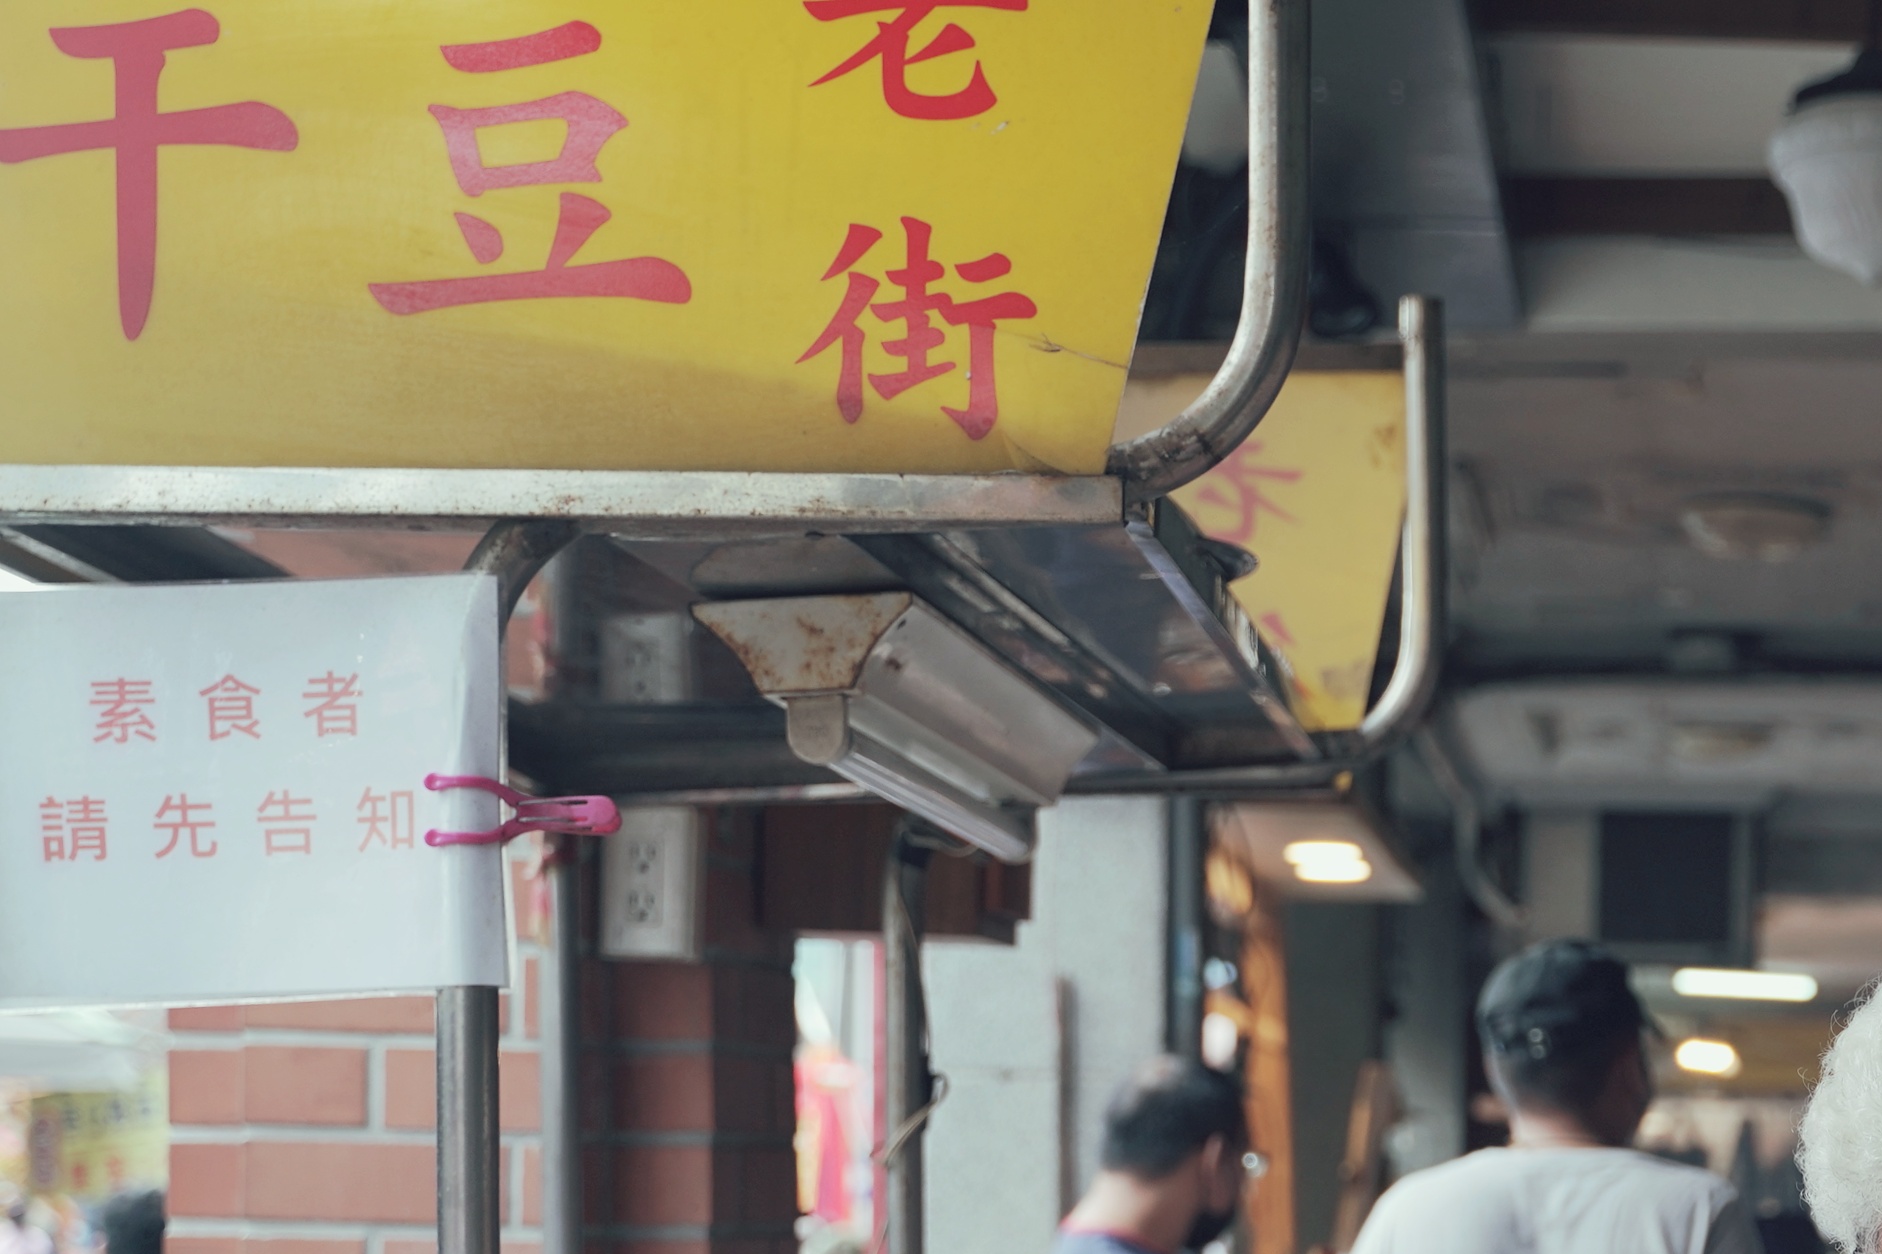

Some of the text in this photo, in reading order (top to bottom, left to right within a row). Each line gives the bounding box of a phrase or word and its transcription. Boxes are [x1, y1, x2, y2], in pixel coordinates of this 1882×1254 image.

[89, 669, 364, 745] 素食者
[38, 785, 416, 863] 請先告知
